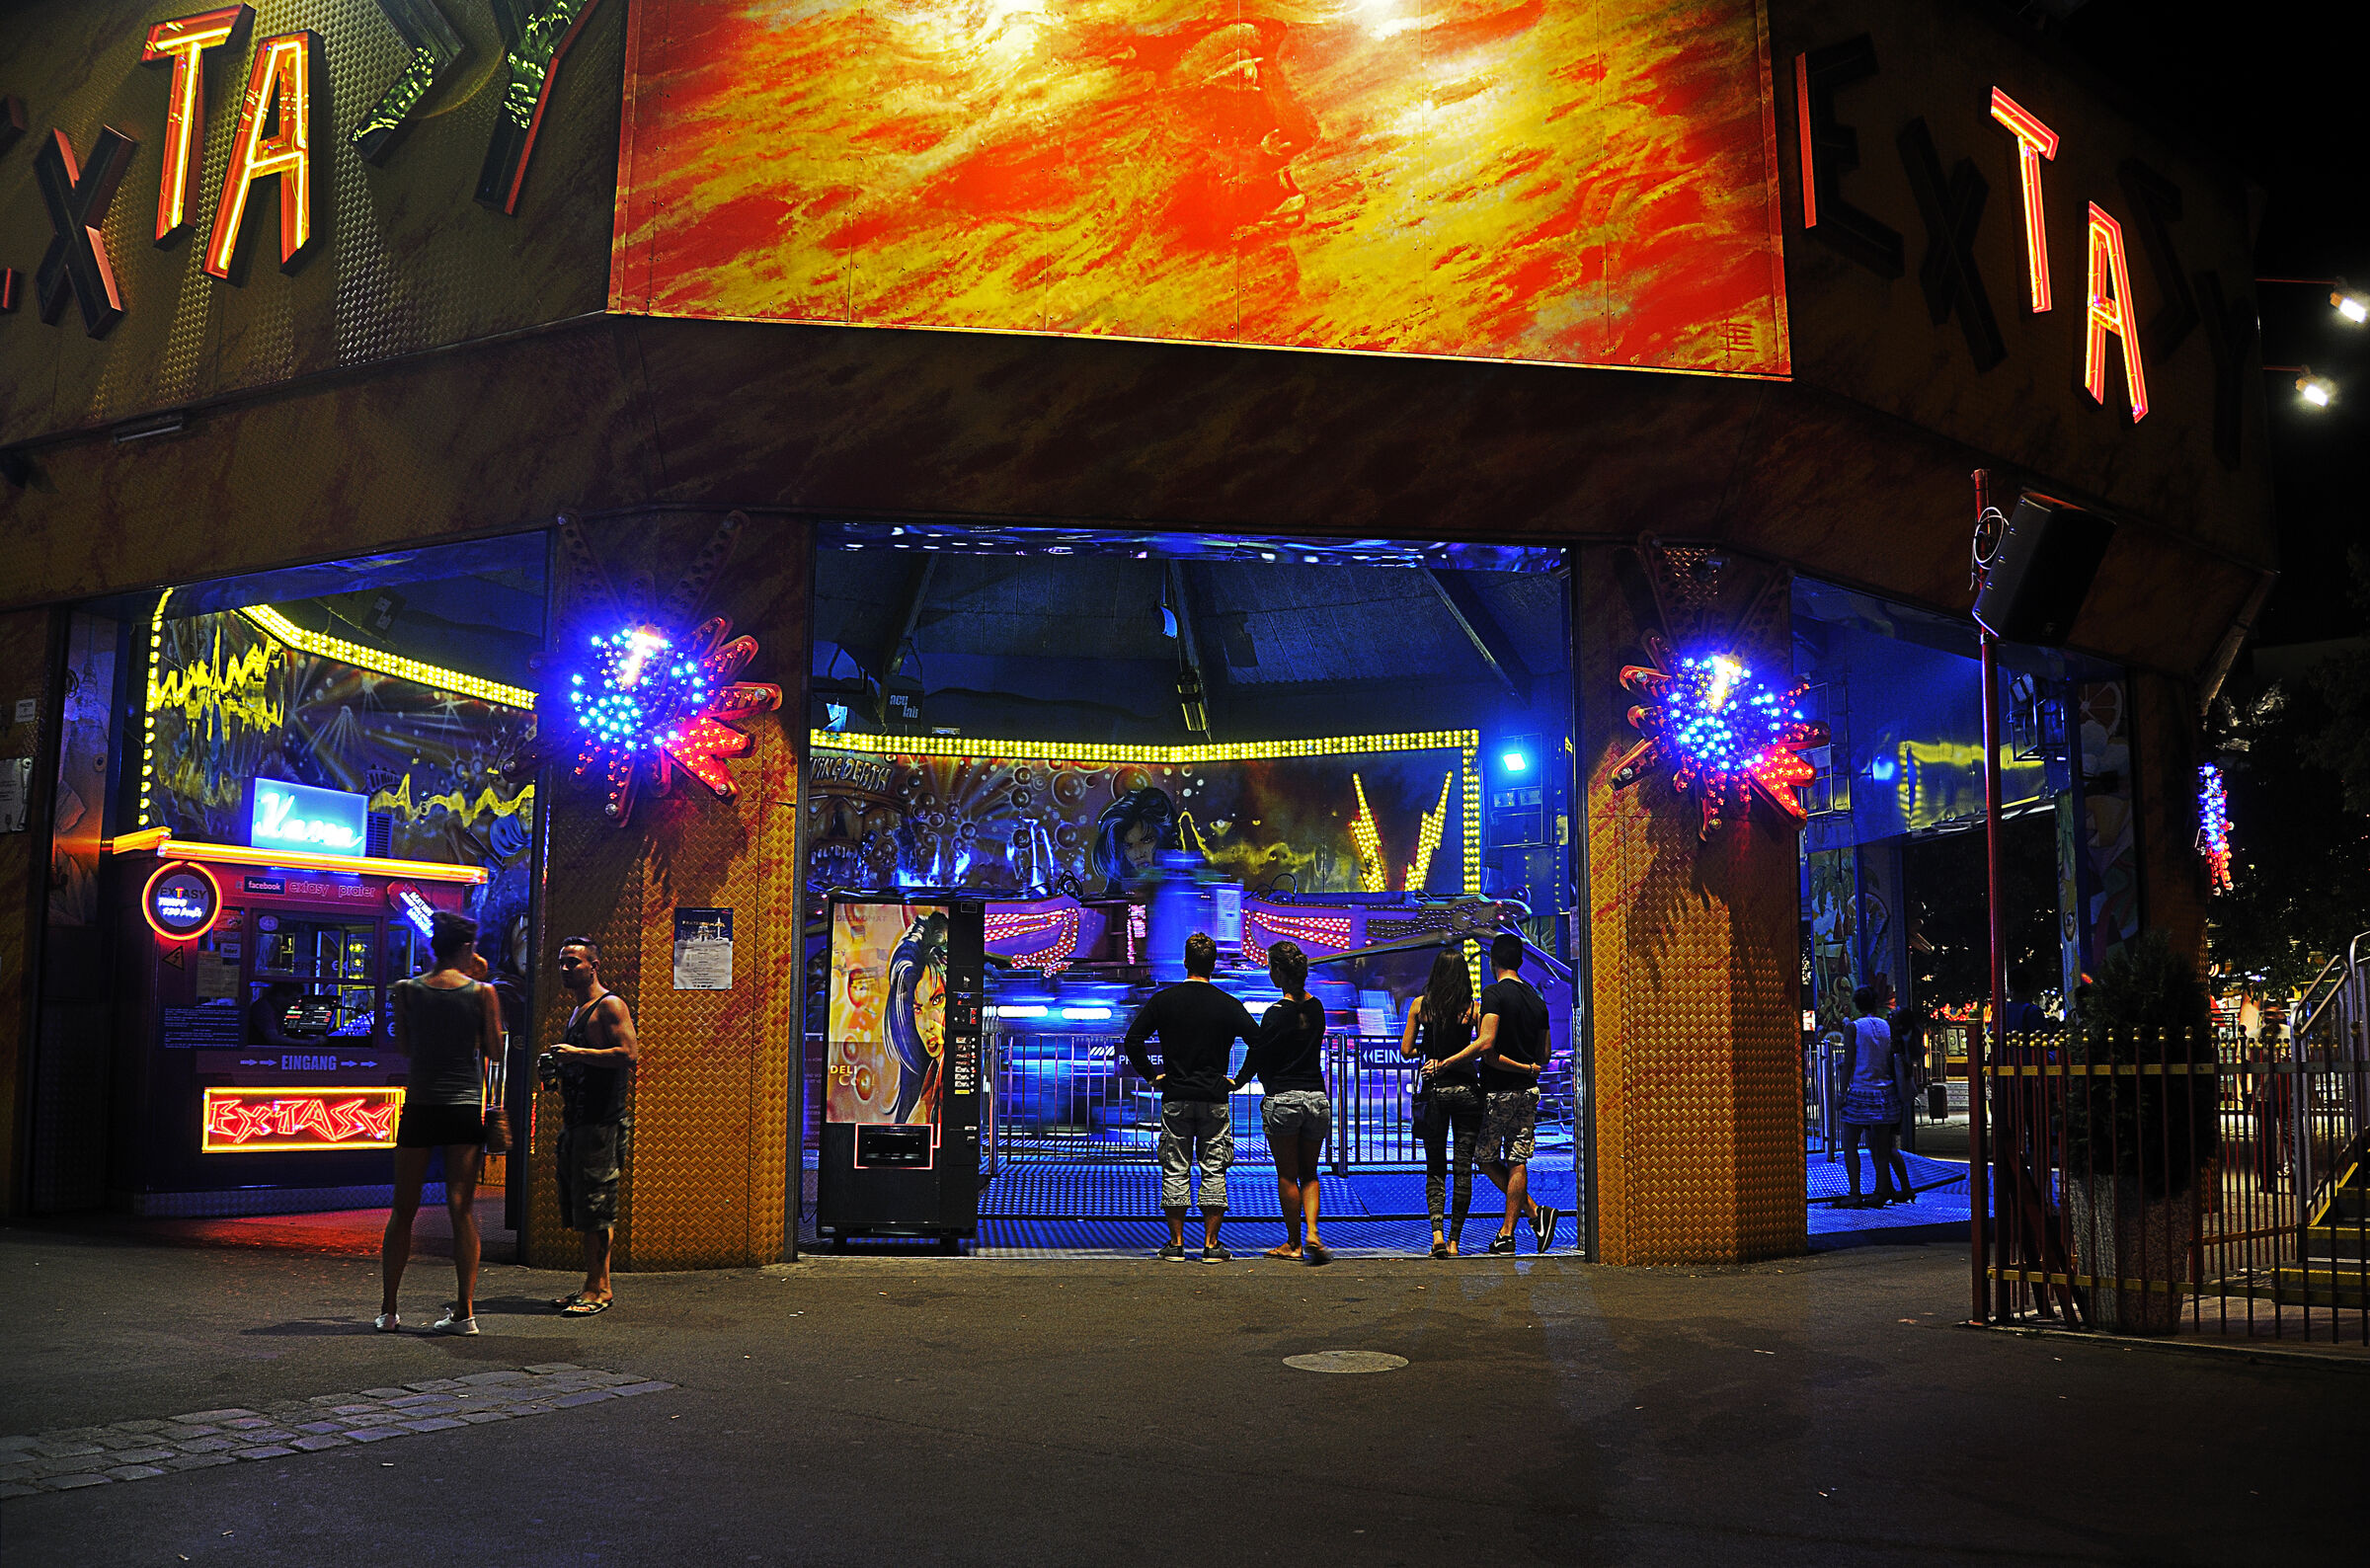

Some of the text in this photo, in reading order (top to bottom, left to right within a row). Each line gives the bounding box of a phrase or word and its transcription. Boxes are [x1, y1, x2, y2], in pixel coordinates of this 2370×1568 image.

[248, 881, 281, 891] facebook
[281, 1055, 337, 1070] EINGANG
[830, 1064, 857, 1074] DELI
[208, 1098, 397, 1144] EXTASY
